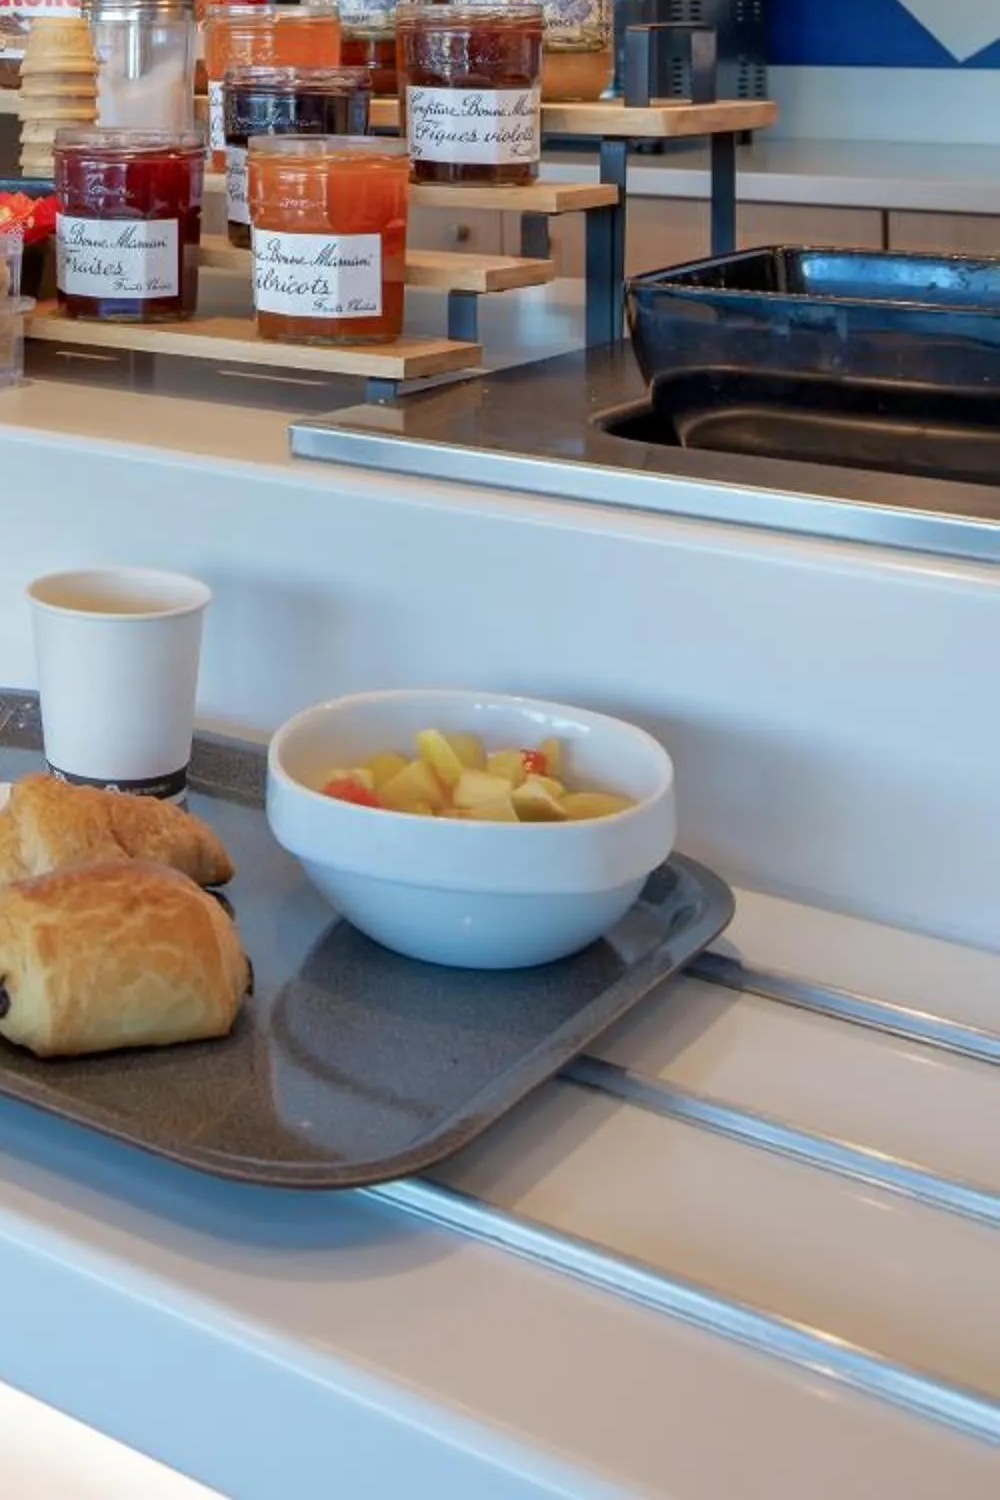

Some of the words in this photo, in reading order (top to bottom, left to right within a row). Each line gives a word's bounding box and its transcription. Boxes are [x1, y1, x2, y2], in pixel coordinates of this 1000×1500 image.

[415, 119, 480, 146] Figues
[110, 225, 167, 249] Maman
[311, 243, 371, 267] Maman
